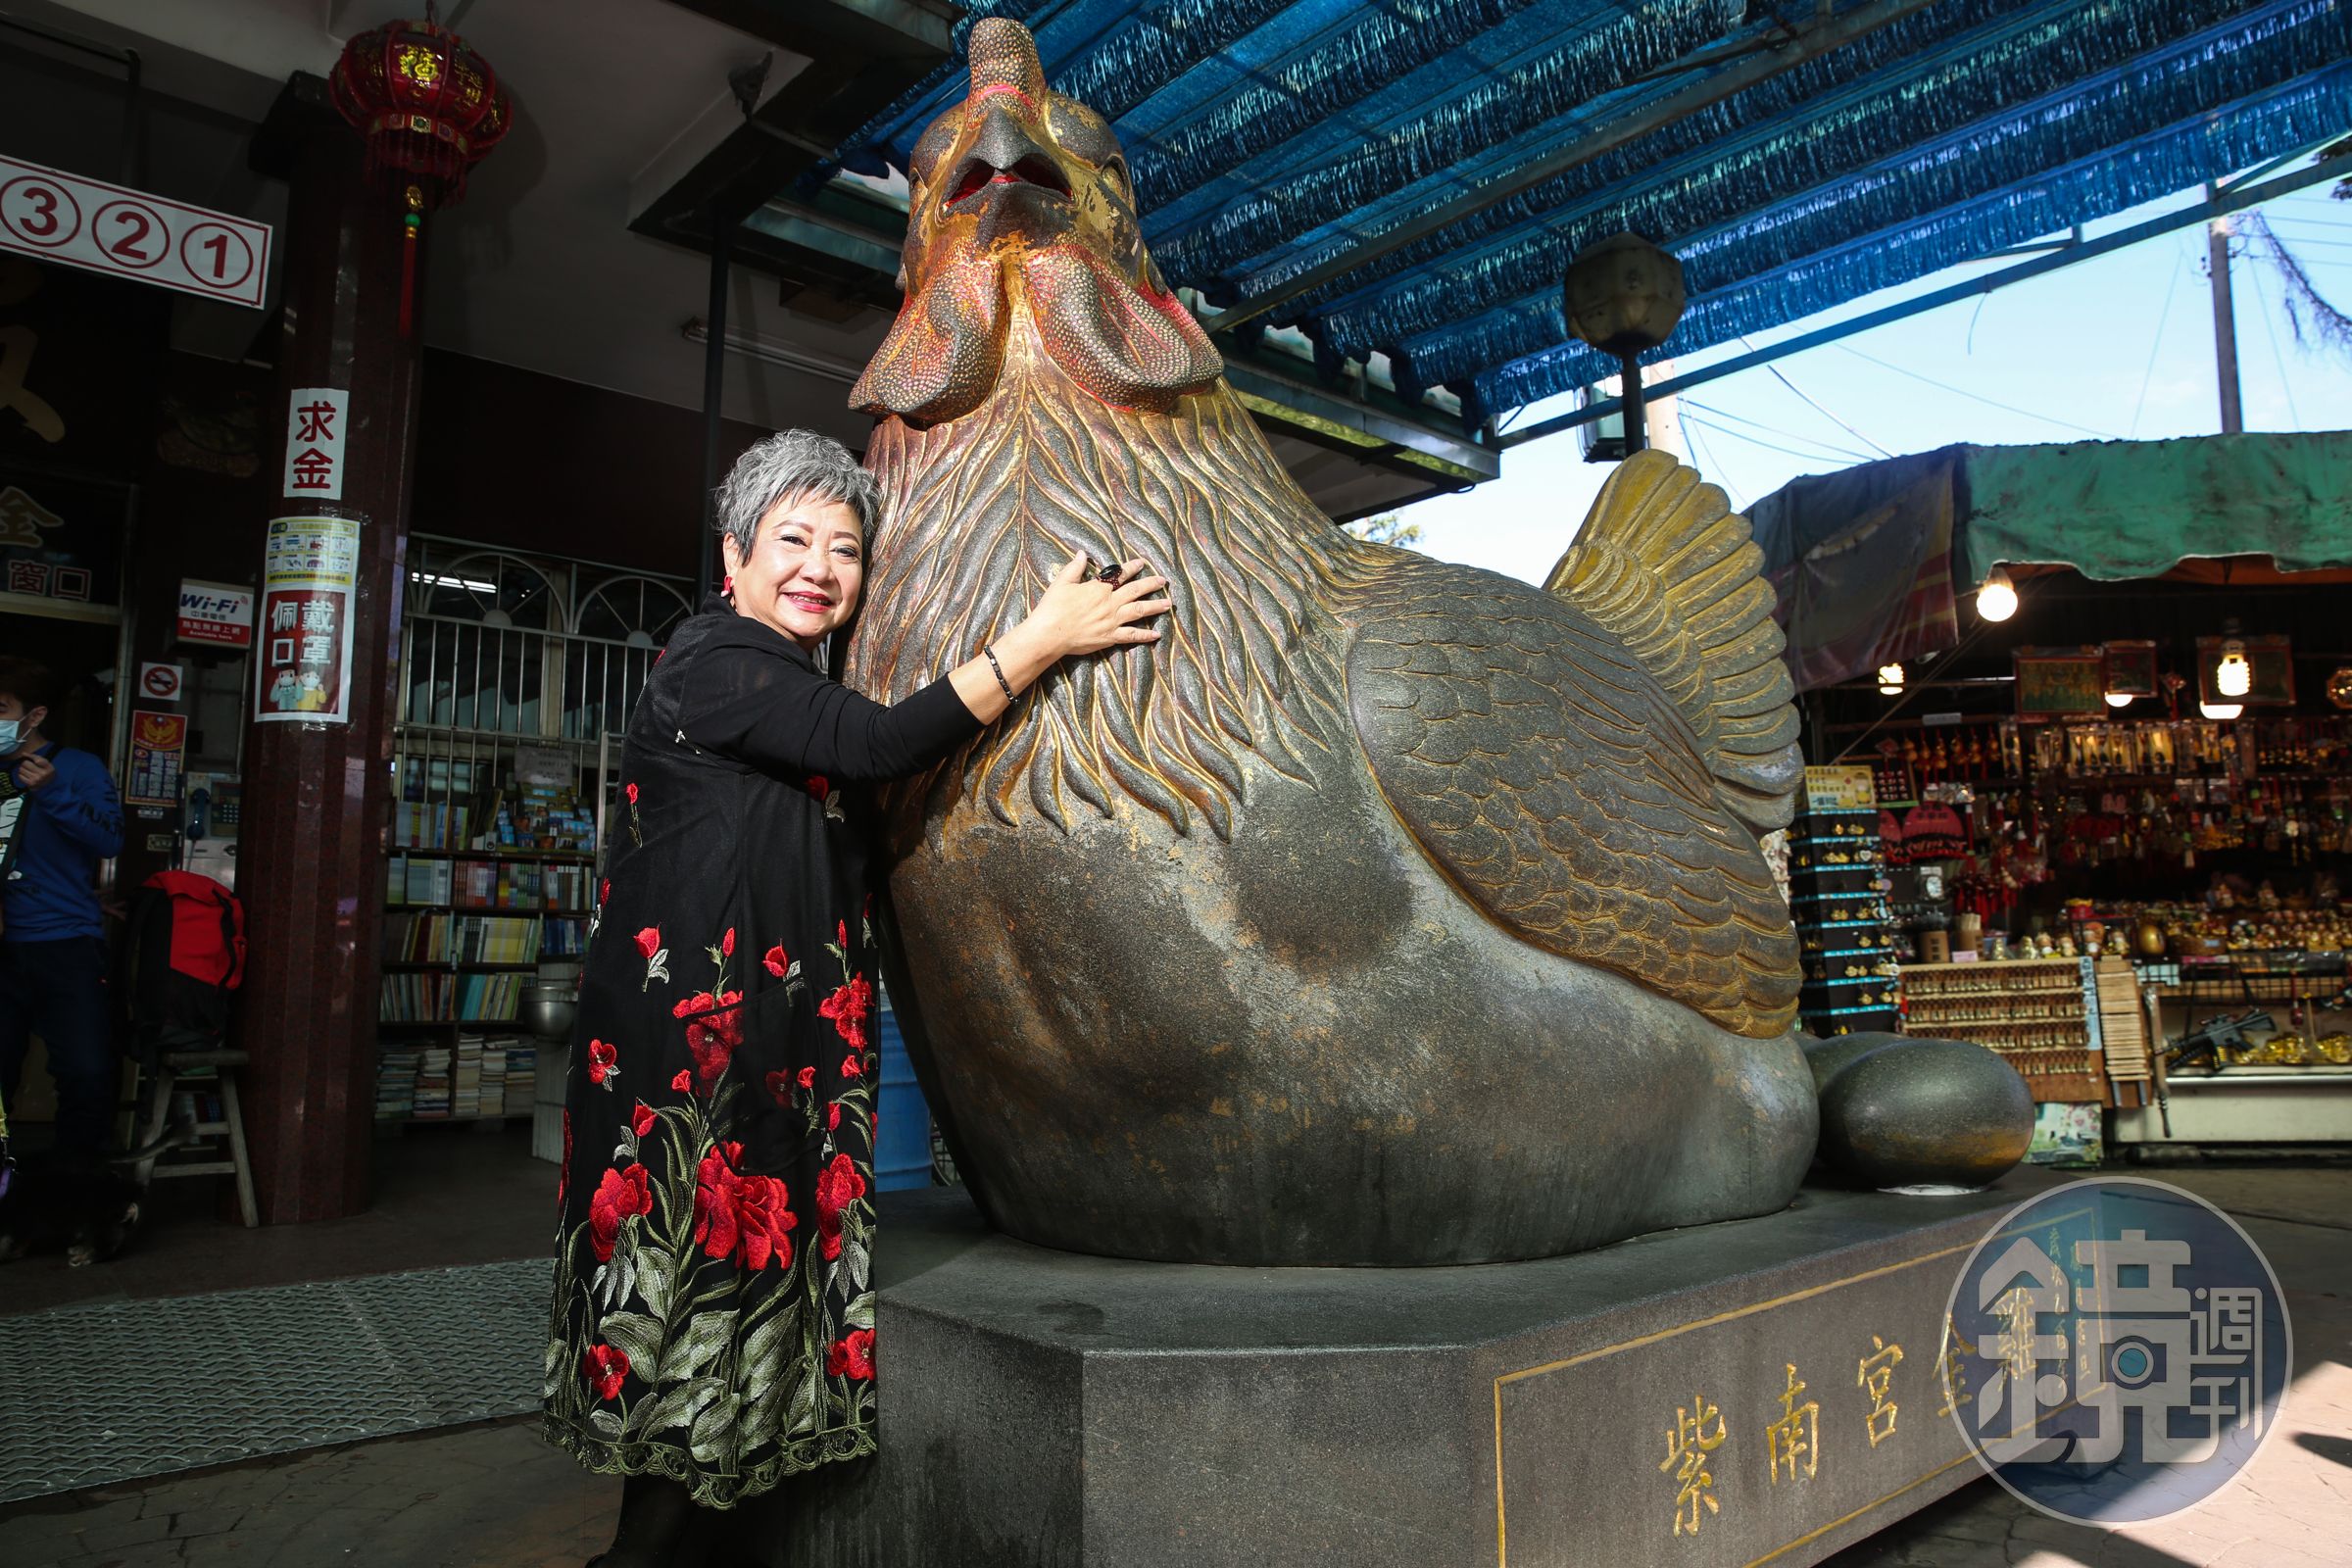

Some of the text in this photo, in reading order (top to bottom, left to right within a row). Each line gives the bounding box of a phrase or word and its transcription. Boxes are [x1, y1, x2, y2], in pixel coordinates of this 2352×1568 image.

[20, 187, 58, 236] 3
[111, 211, 150, 261] 2
[292, 401, 336, 489] 求金
[8, 559, 92, 602] 窗口
[180, 594, 239, 613] Wi-Fi
